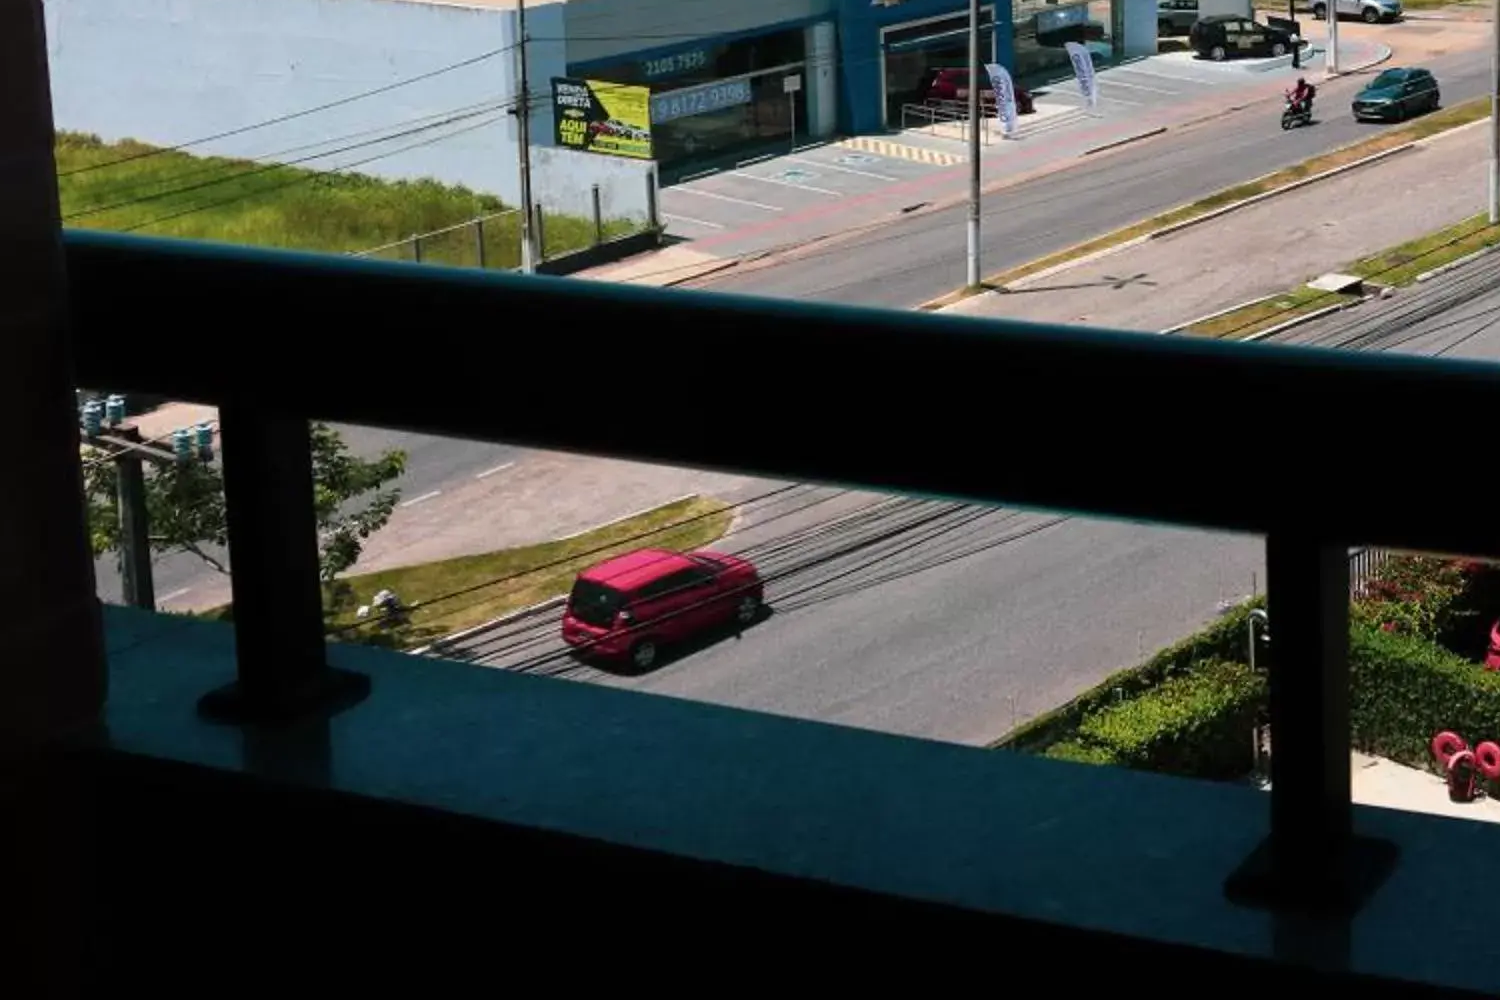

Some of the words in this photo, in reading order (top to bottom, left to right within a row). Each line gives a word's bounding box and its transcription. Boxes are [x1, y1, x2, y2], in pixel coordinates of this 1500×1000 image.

[557, 95, 591, 109] DIRETA
[560, 119, 587, 133] AQUI
[561, 131, 584, 145] TEM
